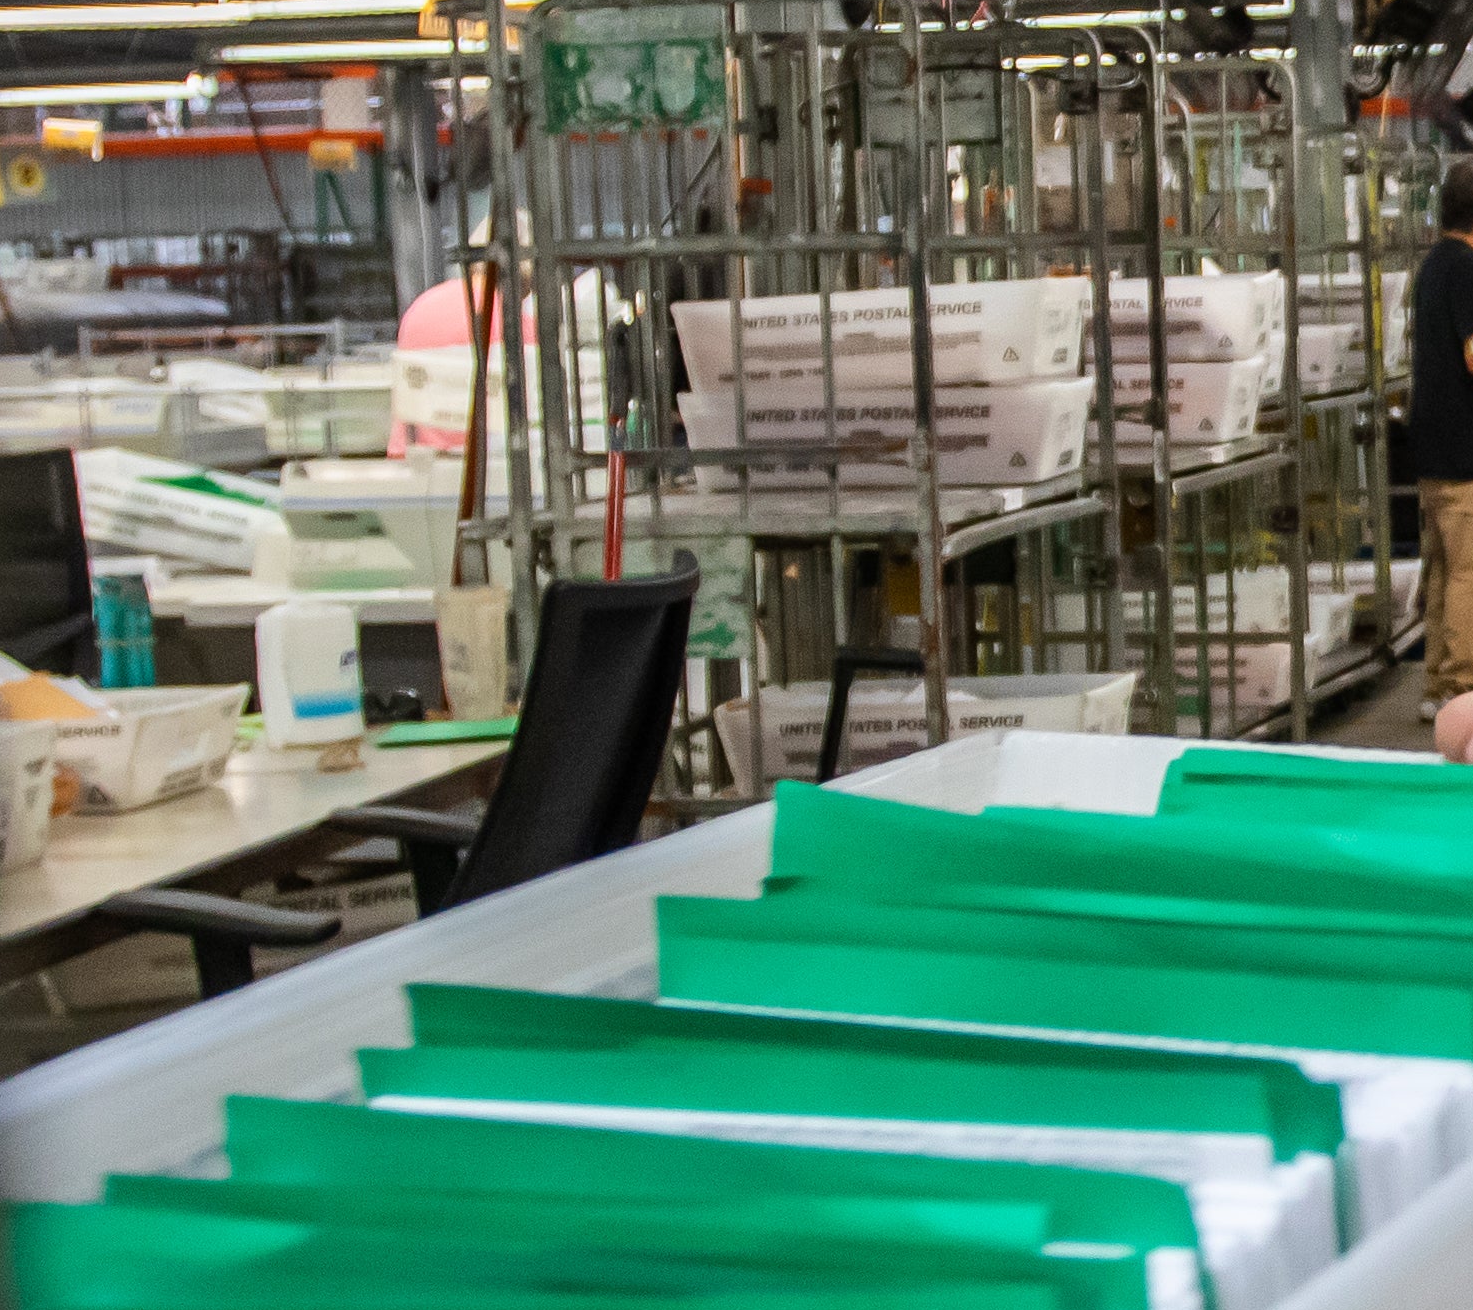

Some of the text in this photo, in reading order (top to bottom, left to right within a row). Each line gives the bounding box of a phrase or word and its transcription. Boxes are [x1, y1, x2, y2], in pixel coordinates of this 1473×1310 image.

[793, 312, 849, 327] STAES
[929, 301, 983, 316] ERVICE
[800, 406, 856, 421] STAES
[933, 404, 990, 419] ERVICE
[779, 721, 824, 736] UNITE
[848, 719, 893, 734] TATES
[959, 714, 1024, 730] SERVICE
